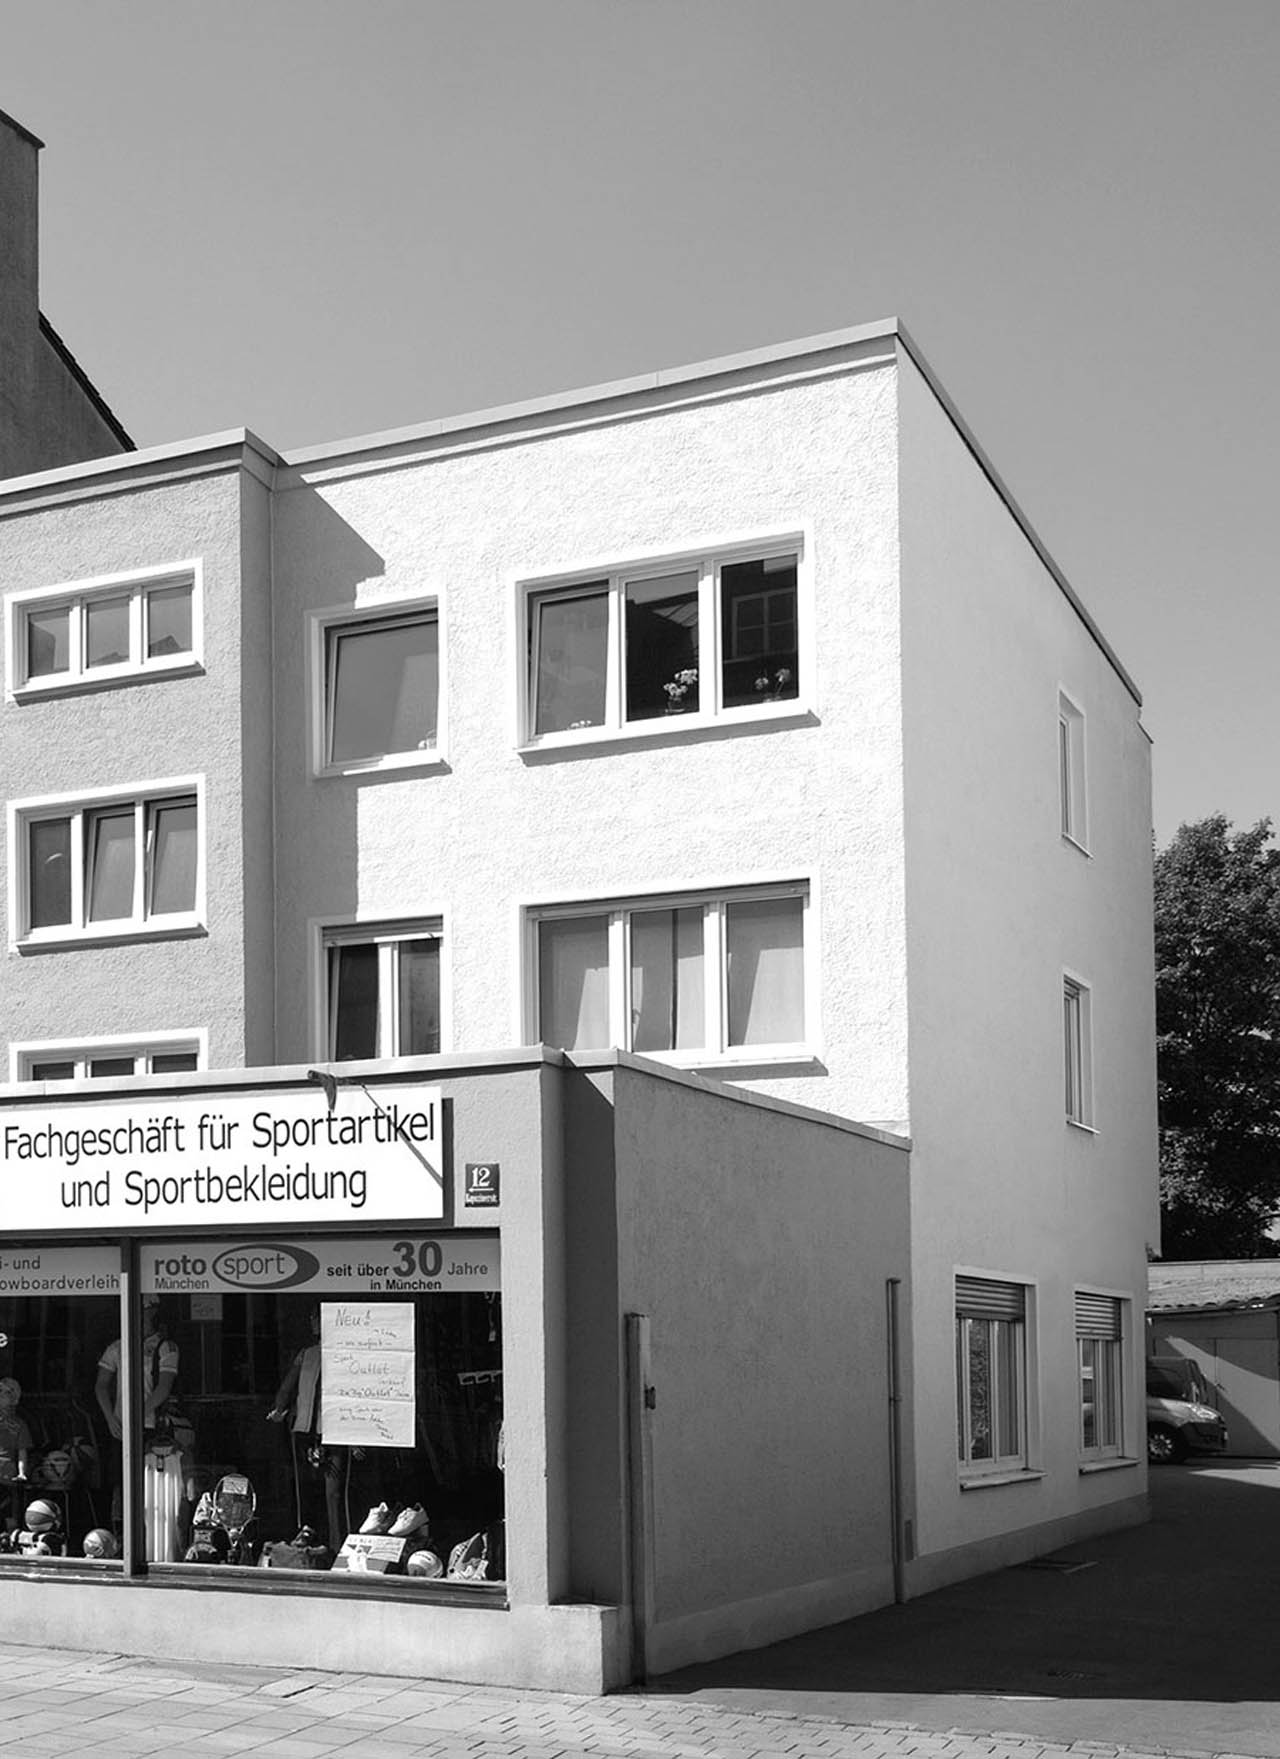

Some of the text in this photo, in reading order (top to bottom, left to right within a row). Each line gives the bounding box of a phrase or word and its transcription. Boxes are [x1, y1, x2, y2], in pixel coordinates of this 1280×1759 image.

[4, 1103, 435, 1165] Fachgeschäft für Sportartikel
[61, 1163, 367, 1214] und Sportbekleidung
[471, 1167, 490, 1187] 12
[13, 1256, 41, 1270] und
[154, 1253, 285, 1279] roto sport
[327, 1241, 489, 1278] seit über 30 Jahre
[154, 1277, 210, 1290] München
[370, 1278, 442, 1291] in München
